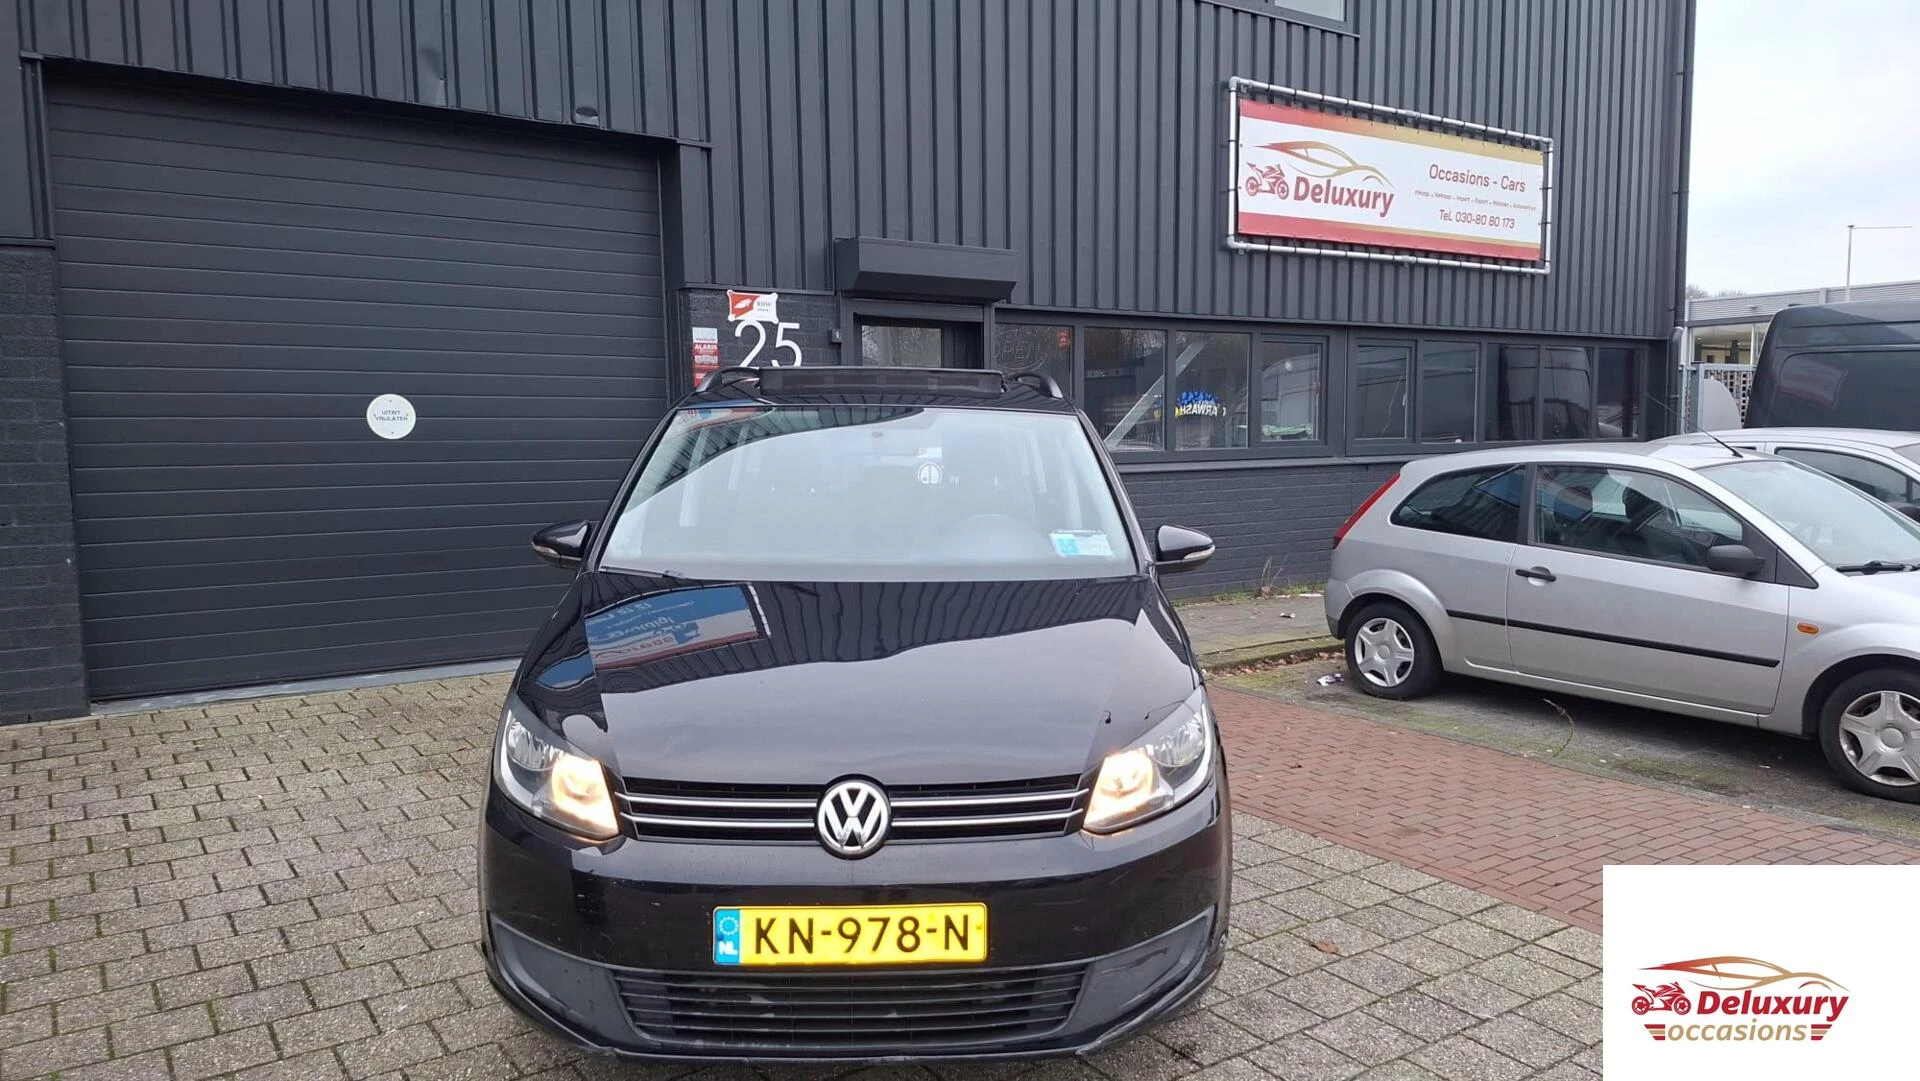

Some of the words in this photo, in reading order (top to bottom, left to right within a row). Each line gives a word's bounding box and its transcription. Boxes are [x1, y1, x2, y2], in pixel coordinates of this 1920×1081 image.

[1429, 164, 1490, 187] Occasions
[1500, 175, 1526, 193] Cars
[1293, 175, 1395, 218] Deluxury
[1455, 211, 1487, 225] 030-80
[1488, 215, 1500, 228] 80
[1502, 217, 1515, 229] 173
[735, 320, 802, 367] 25
[718, 940, 738, 956] NL
[755, 914, 969, 955] KN-978-N
